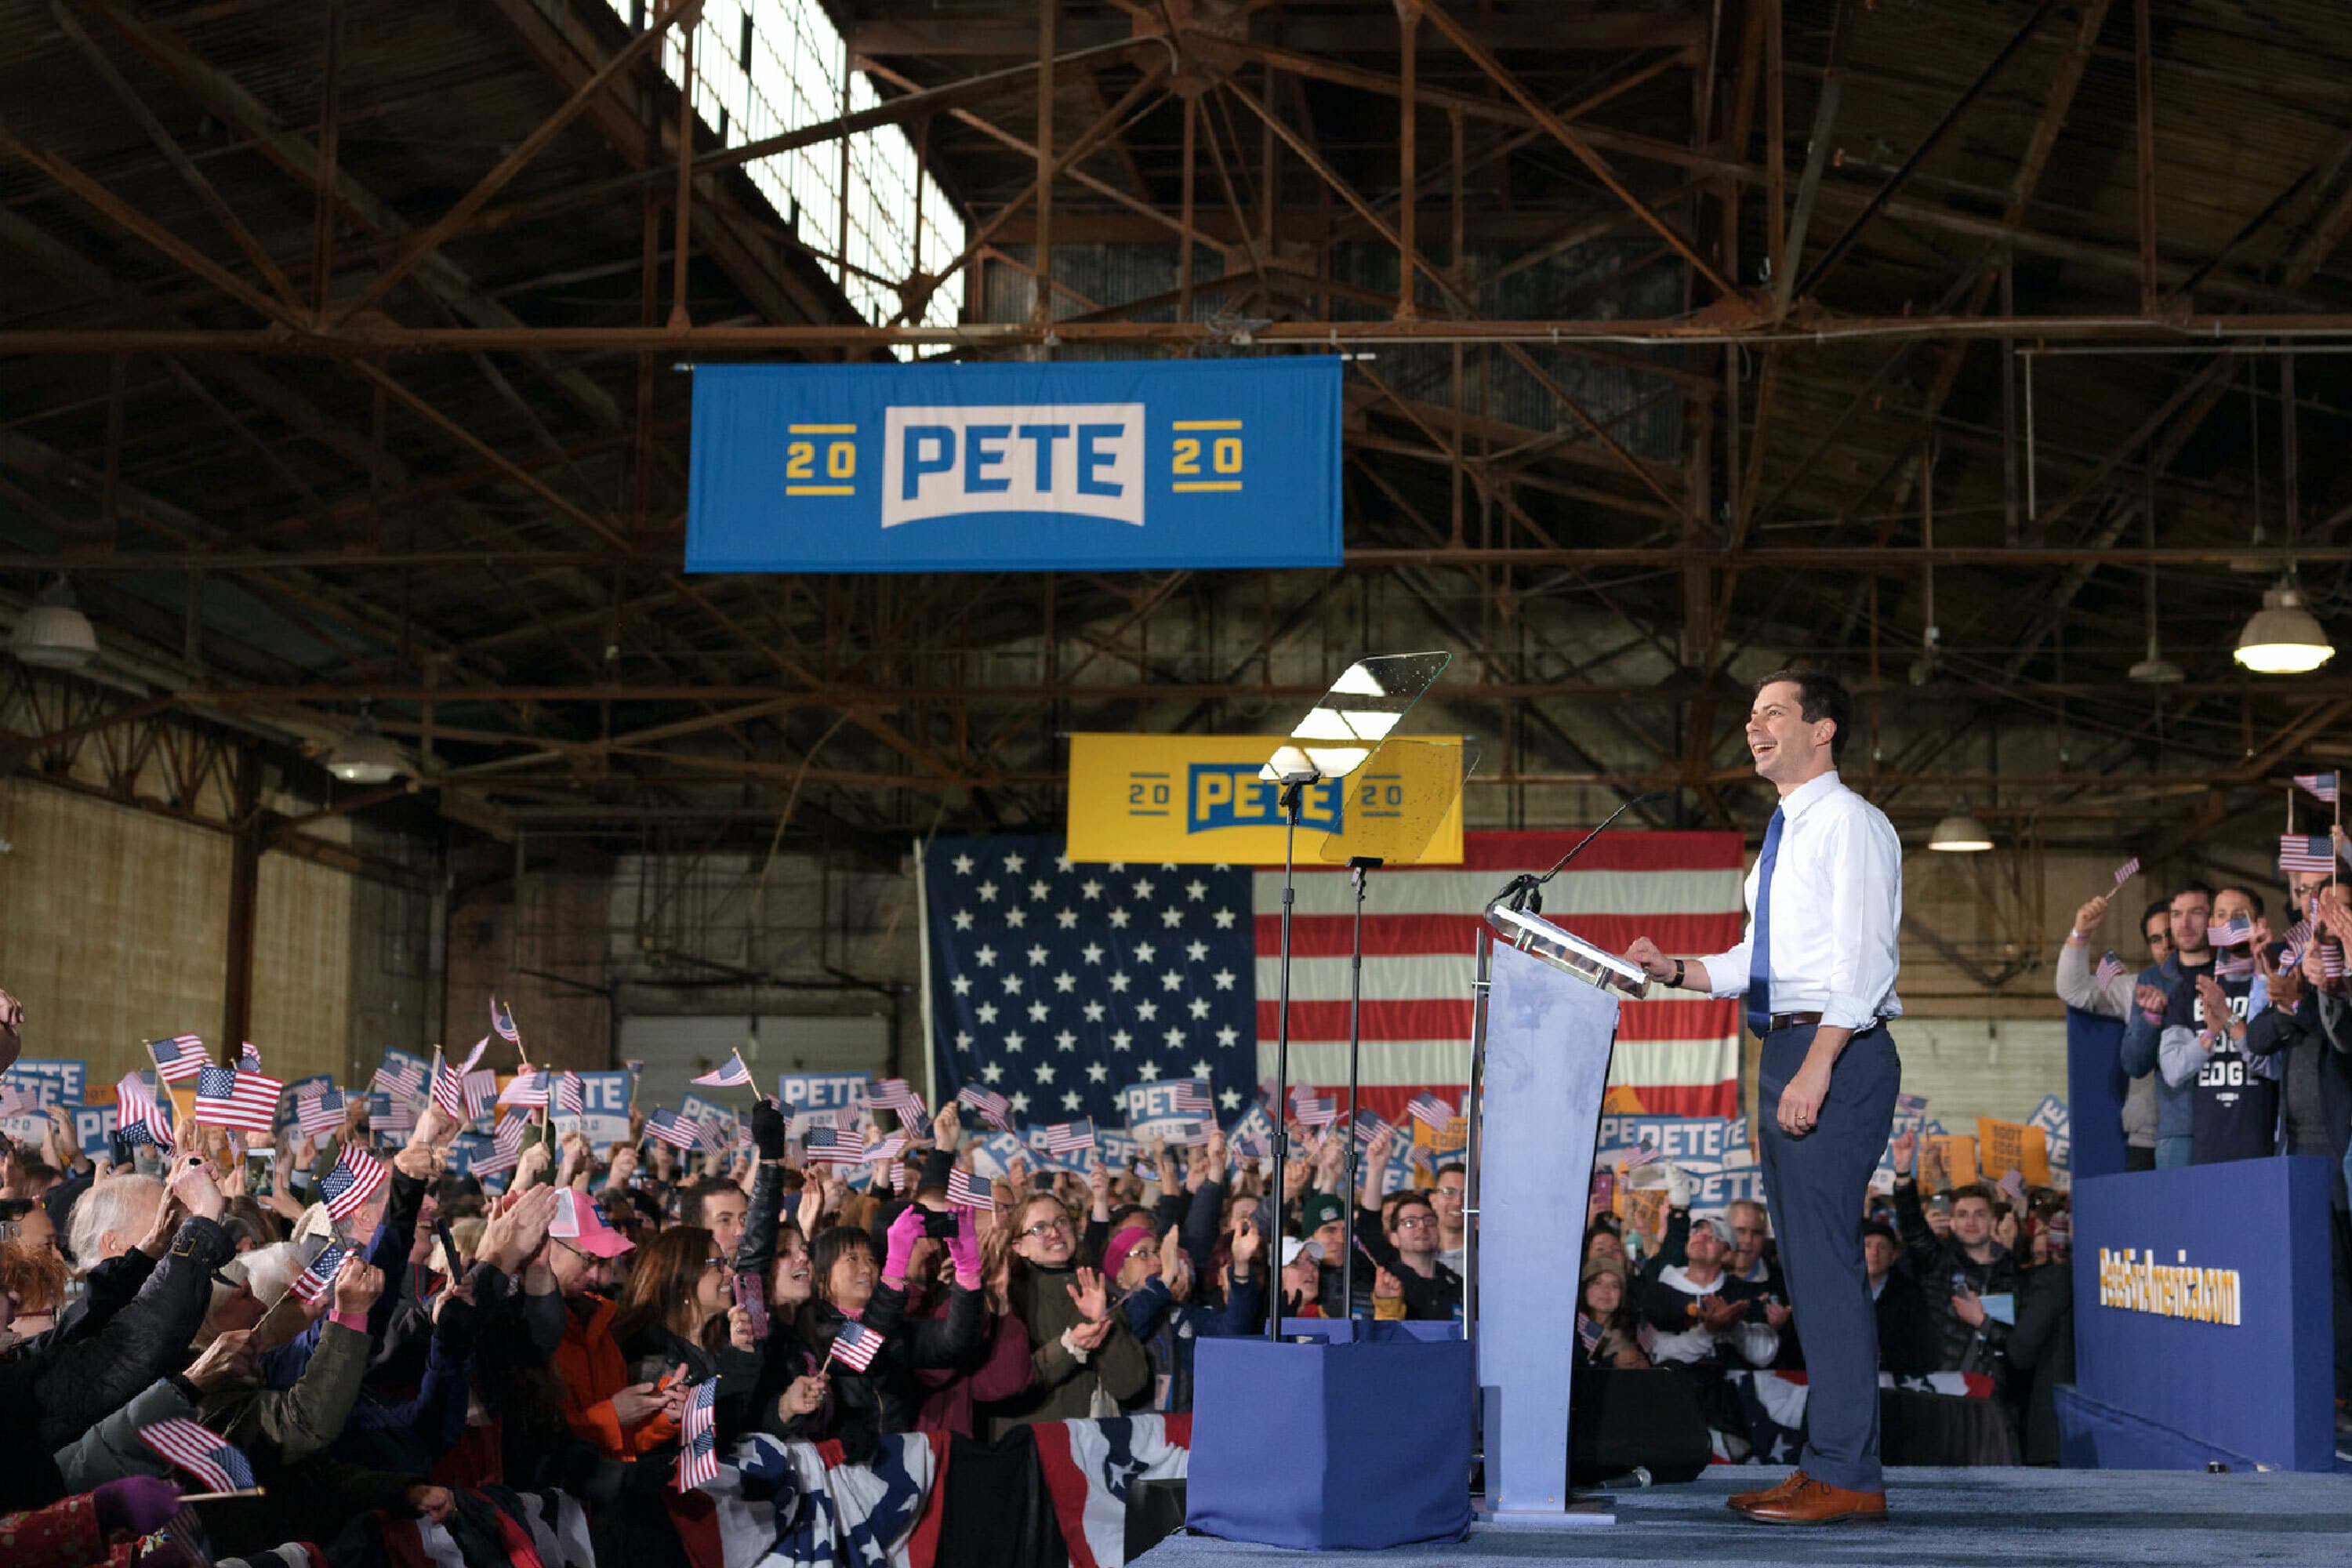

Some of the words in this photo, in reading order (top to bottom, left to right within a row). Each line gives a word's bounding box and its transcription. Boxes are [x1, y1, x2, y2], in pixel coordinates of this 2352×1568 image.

[786, 441, 855, 479] 20
[902, 423, 1126, 502] PETE
[1172, 437, 1243, 474] 20
[1130, 784, 1169, 804] 20
[1362, 786, 1402, 806] 20
[681, 1097, 735, 1128] PET
[1129, 1086, 1178, 1120] PET
[77, 1110, 118, 1149] PE
[1600, 1118, 1635, 1147] PE
[1639, 1123, 1722, 1156] PETE
